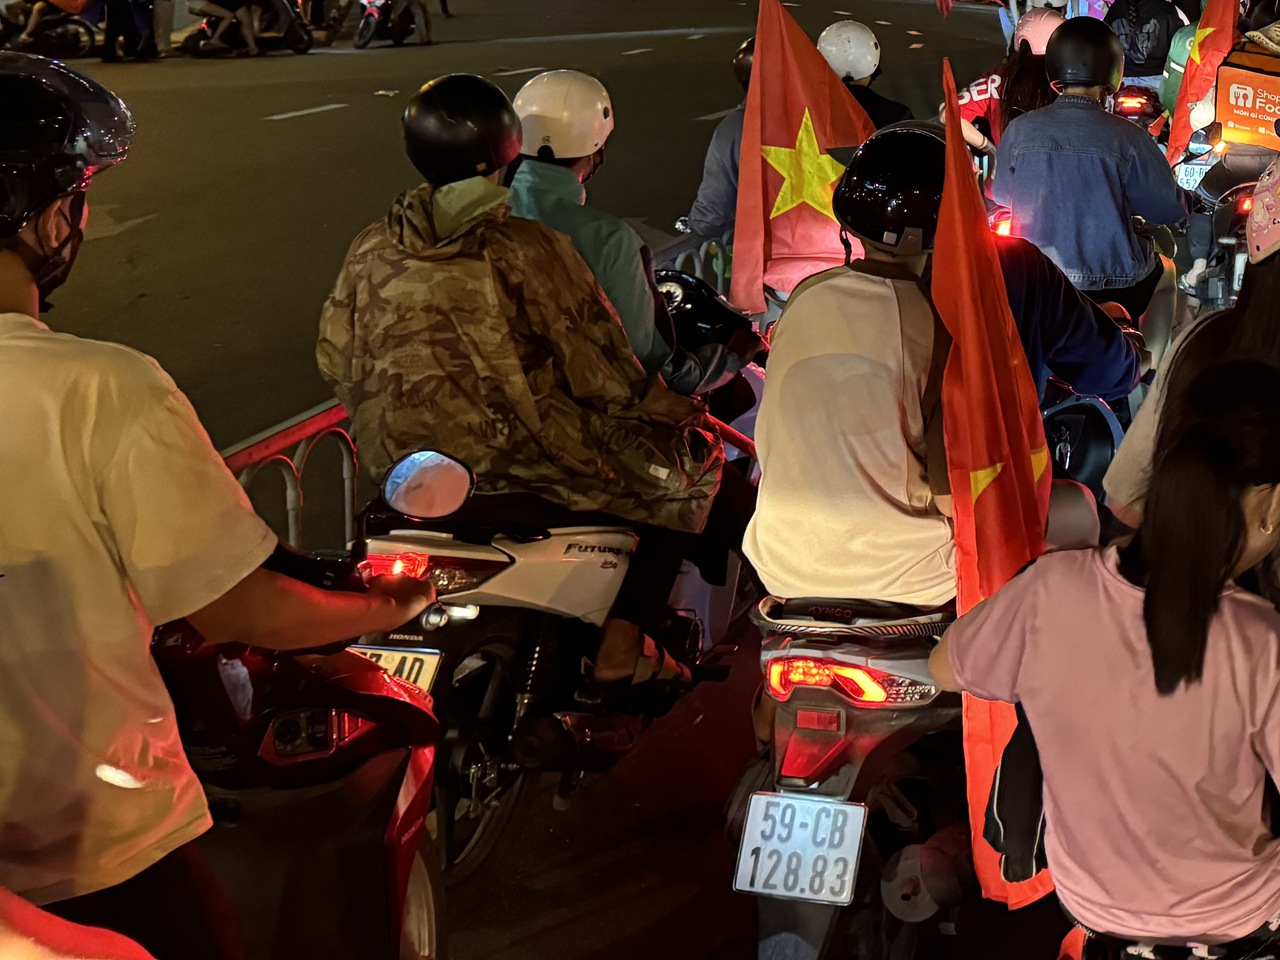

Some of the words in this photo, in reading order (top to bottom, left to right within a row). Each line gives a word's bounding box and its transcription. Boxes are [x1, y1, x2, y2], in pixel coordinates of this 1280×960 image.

[808, 605, 853, 618] KYMCO
[388, 633, 424, 641] HONDA
[760, 800, 849, 849] 59-CB
[749, 846, 850, 897] 128.83
